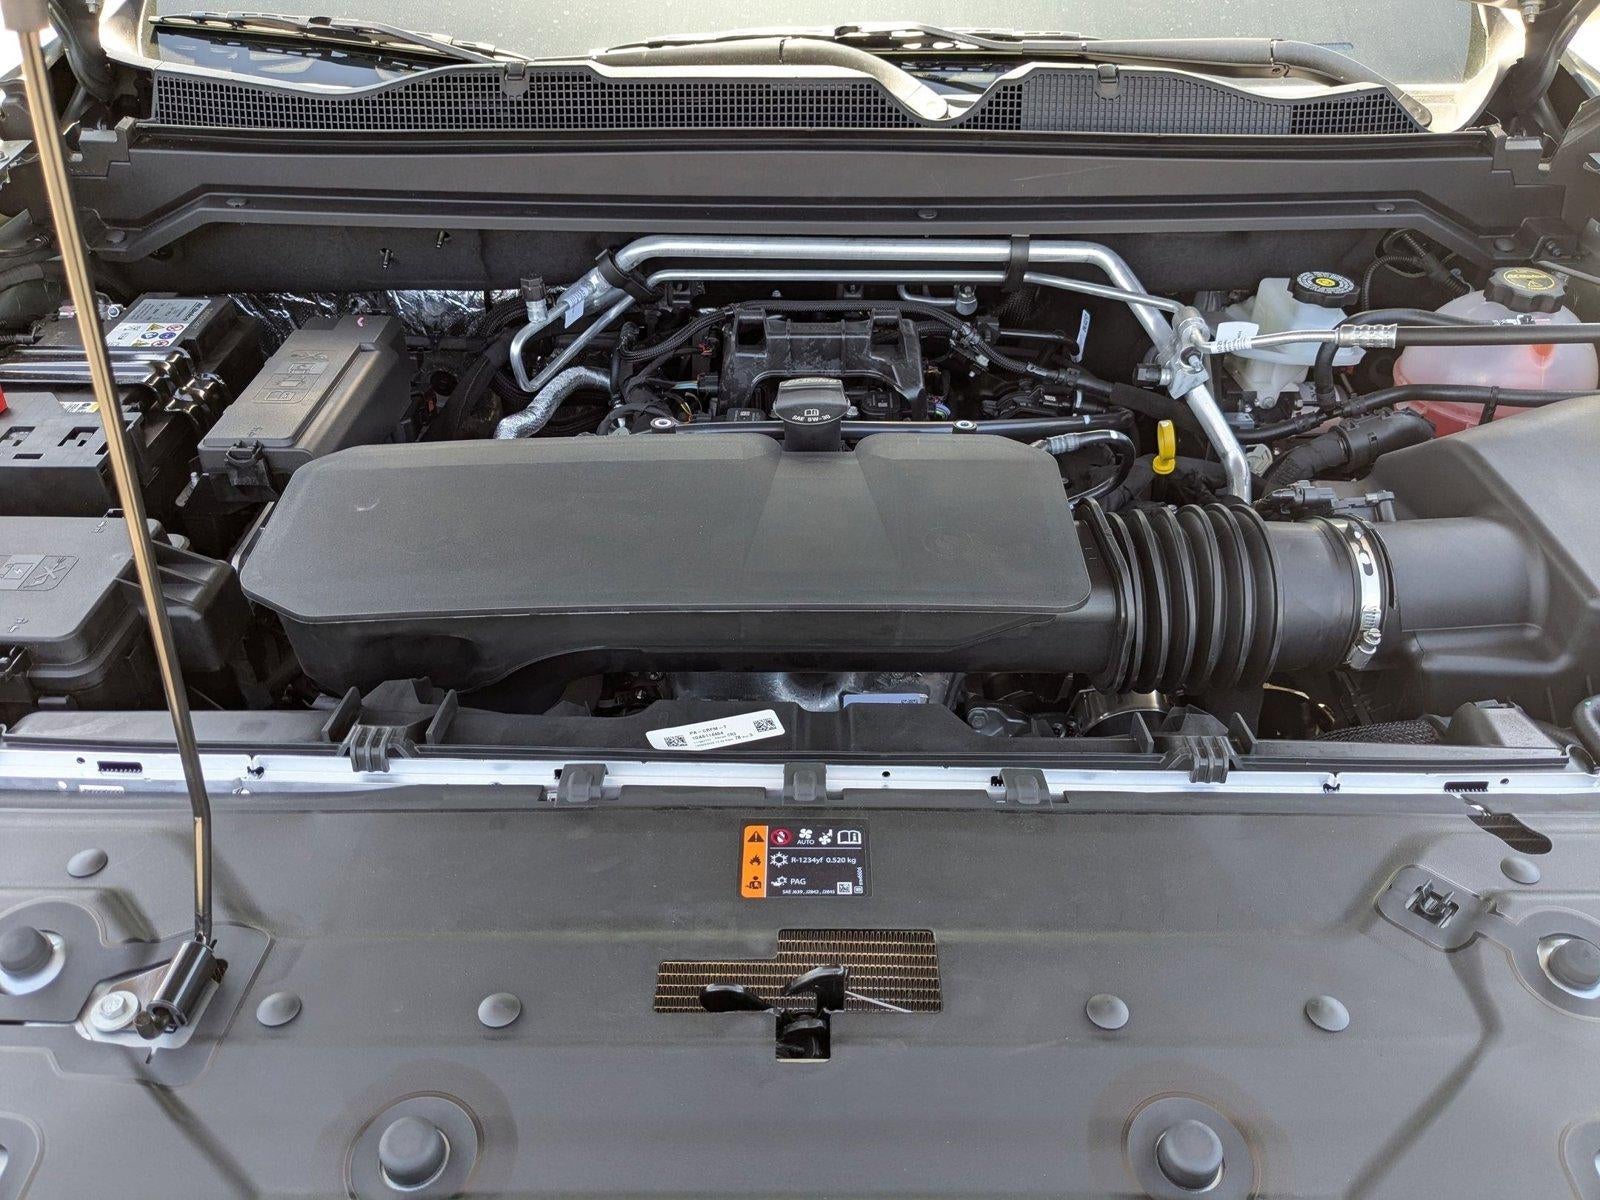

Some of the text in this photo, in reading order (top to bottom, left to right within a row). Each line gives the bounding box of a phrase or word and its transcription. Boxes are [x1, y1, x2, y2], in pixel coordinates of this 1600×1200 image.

[791, 856, 857, 865] R-1234yf 0.520 kg
